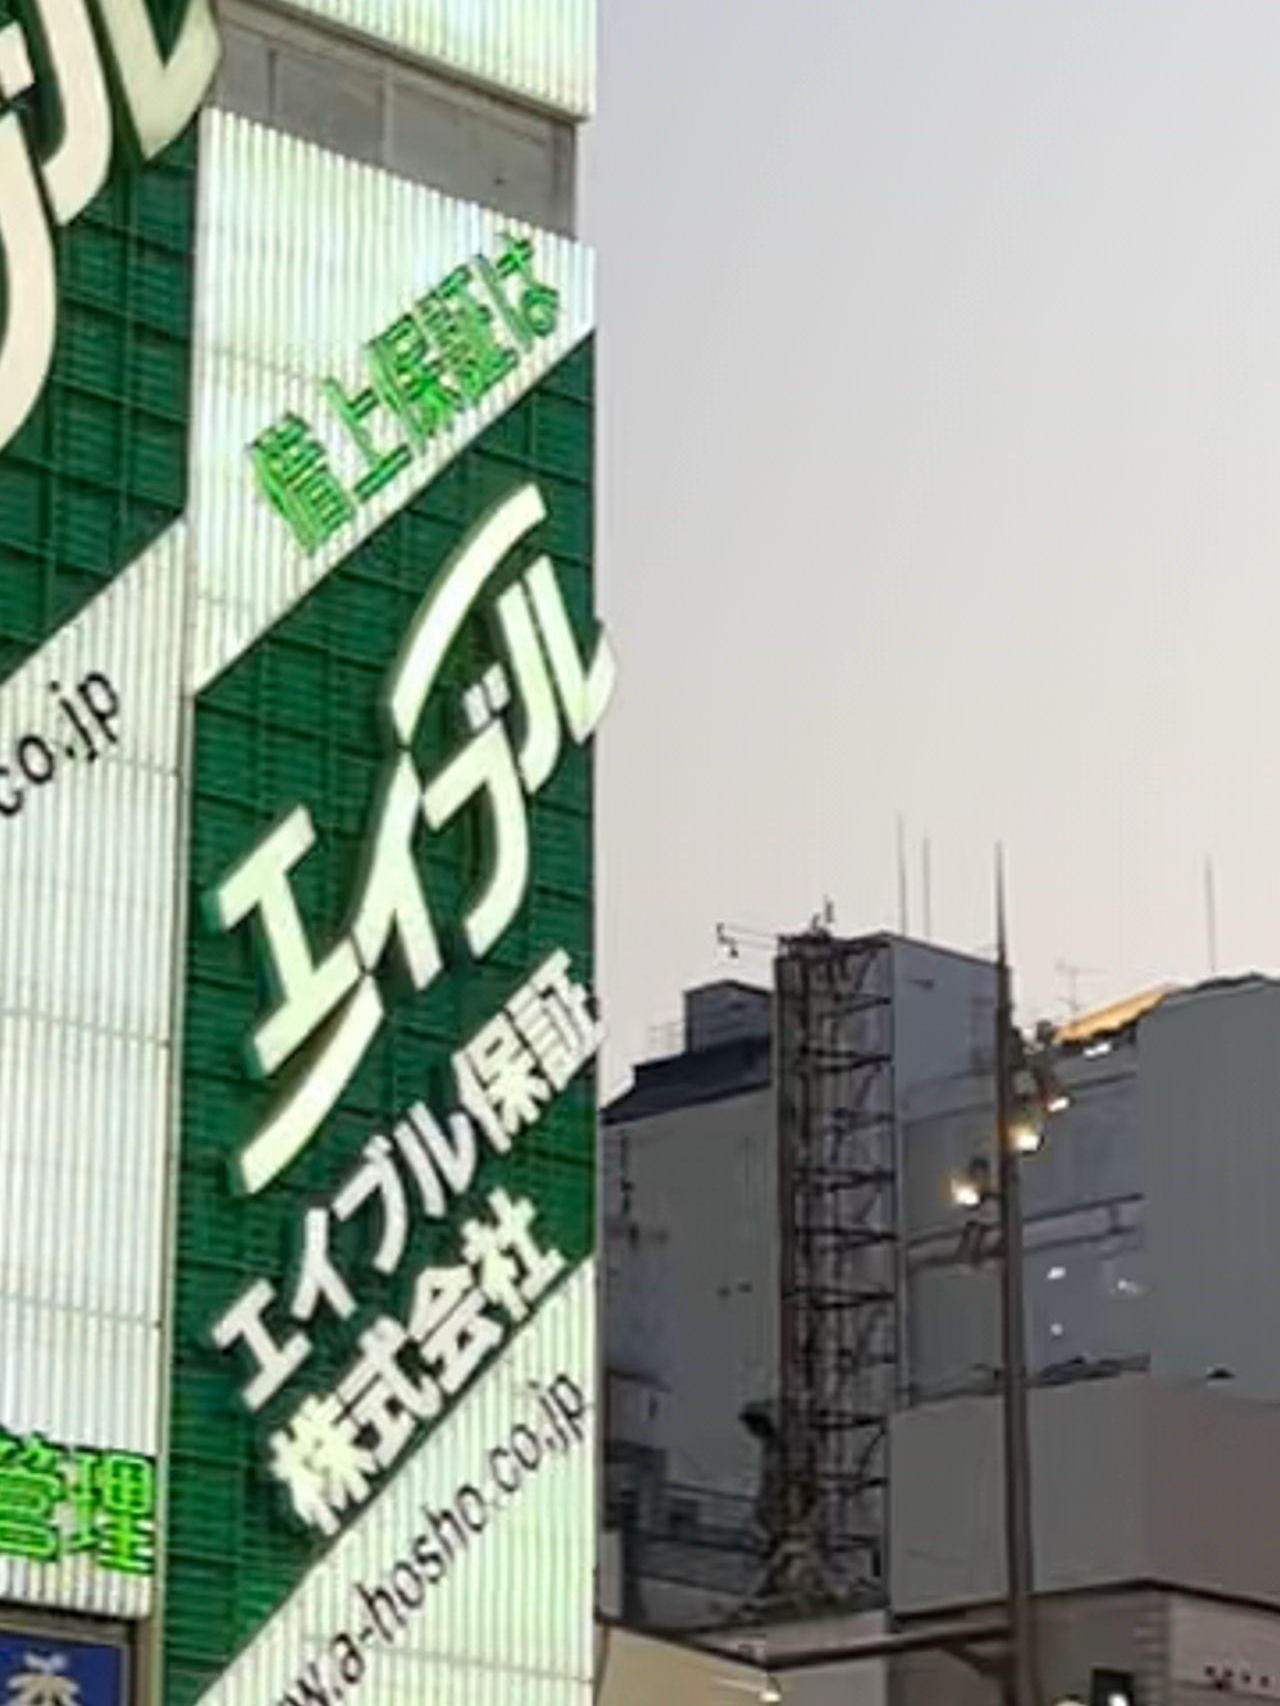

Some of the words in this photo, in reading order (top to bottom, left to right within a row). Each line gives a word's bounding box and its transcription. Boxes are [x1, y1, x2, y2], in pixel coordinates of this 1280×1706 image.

[216, 483, 616, 1193] エイブル
[212, 948, 608, 1411] エイブル保証
[268, 1191, 565, 1536] 株式会社
